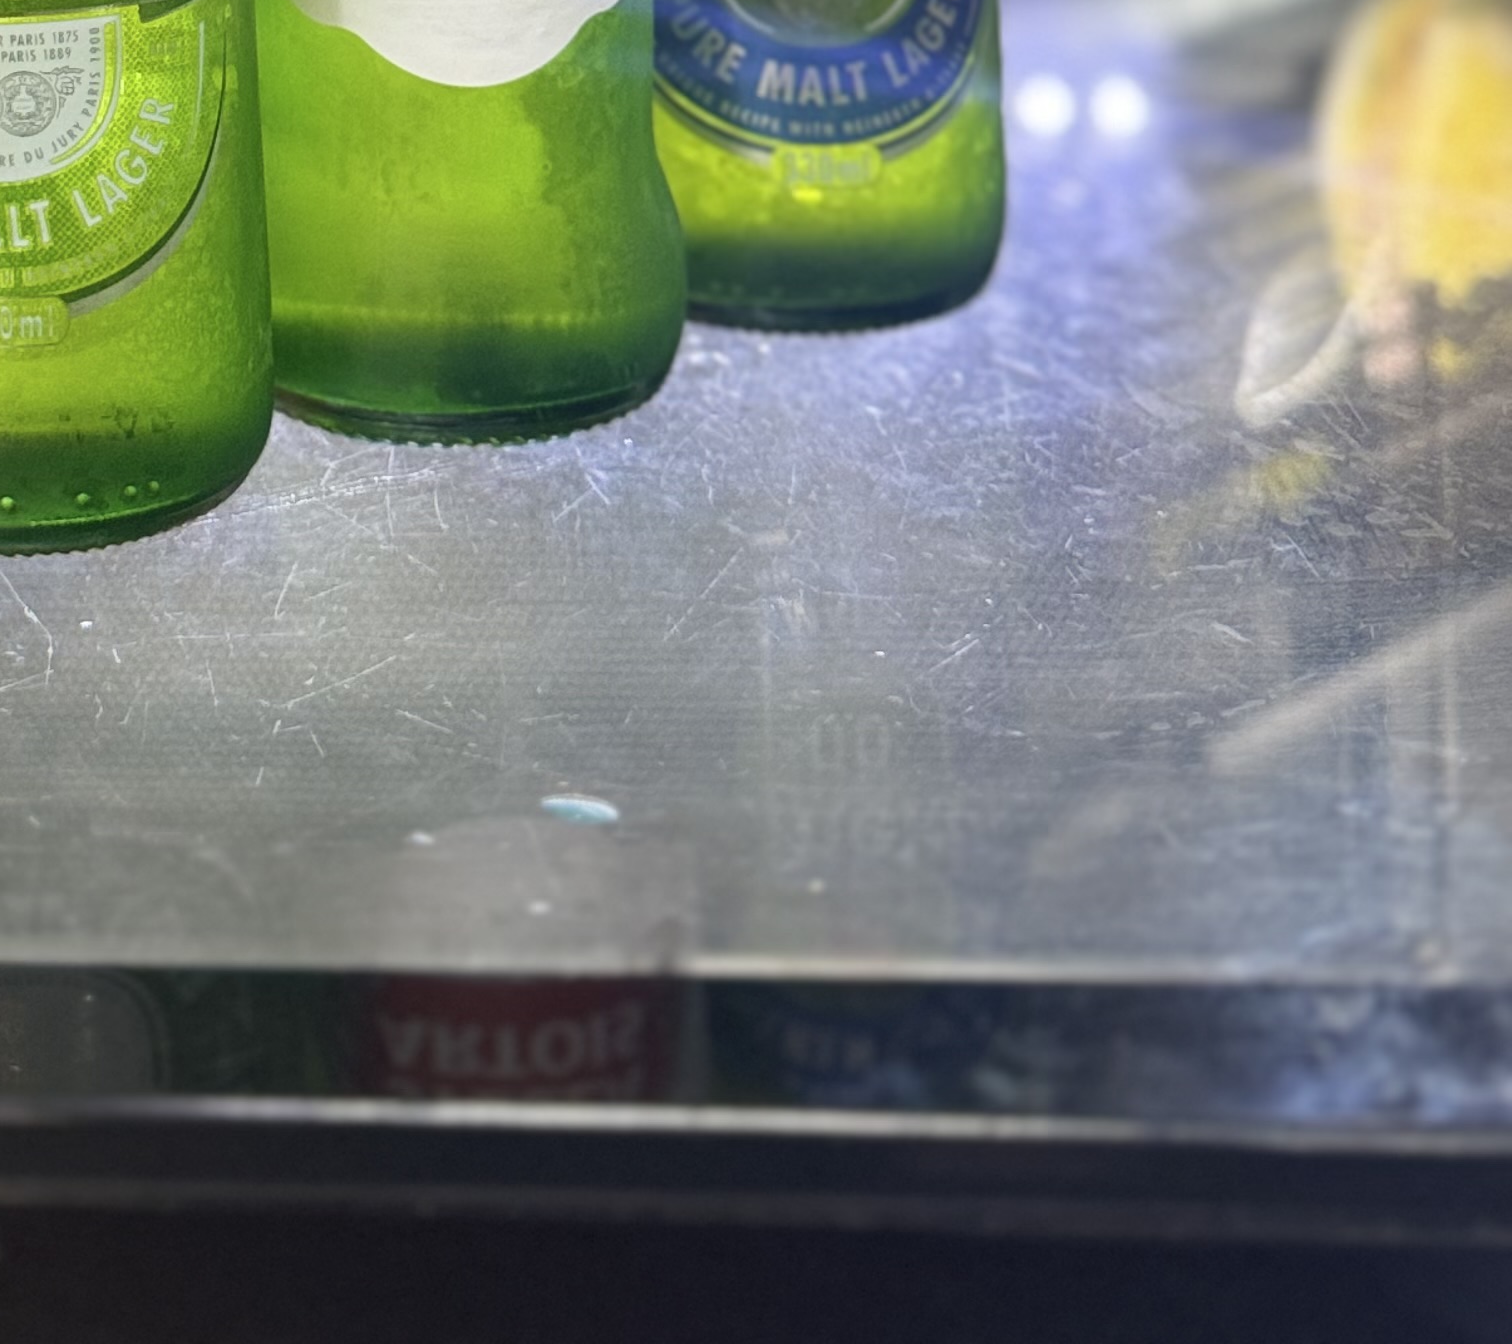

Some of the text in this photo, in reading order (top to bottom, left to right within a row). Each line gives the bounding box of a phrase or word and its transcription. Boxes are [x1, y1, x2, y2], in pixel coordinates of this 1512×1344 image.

[1, 48, 37, 63] PARIS
[43, 46, 73, 62] 1889
[9, 32, 46, 47] PARIS
[52, 29, 80, 44] 1875
[89, 26, 101, 63] 1900
[81, 71, 102, 119] PARIS
[756, 59, 869, 107] MALT
[52, 121, 86, 154] JURY
[23, 149, 45, 163] DU
[73, 96, 175, 230] LAGER
